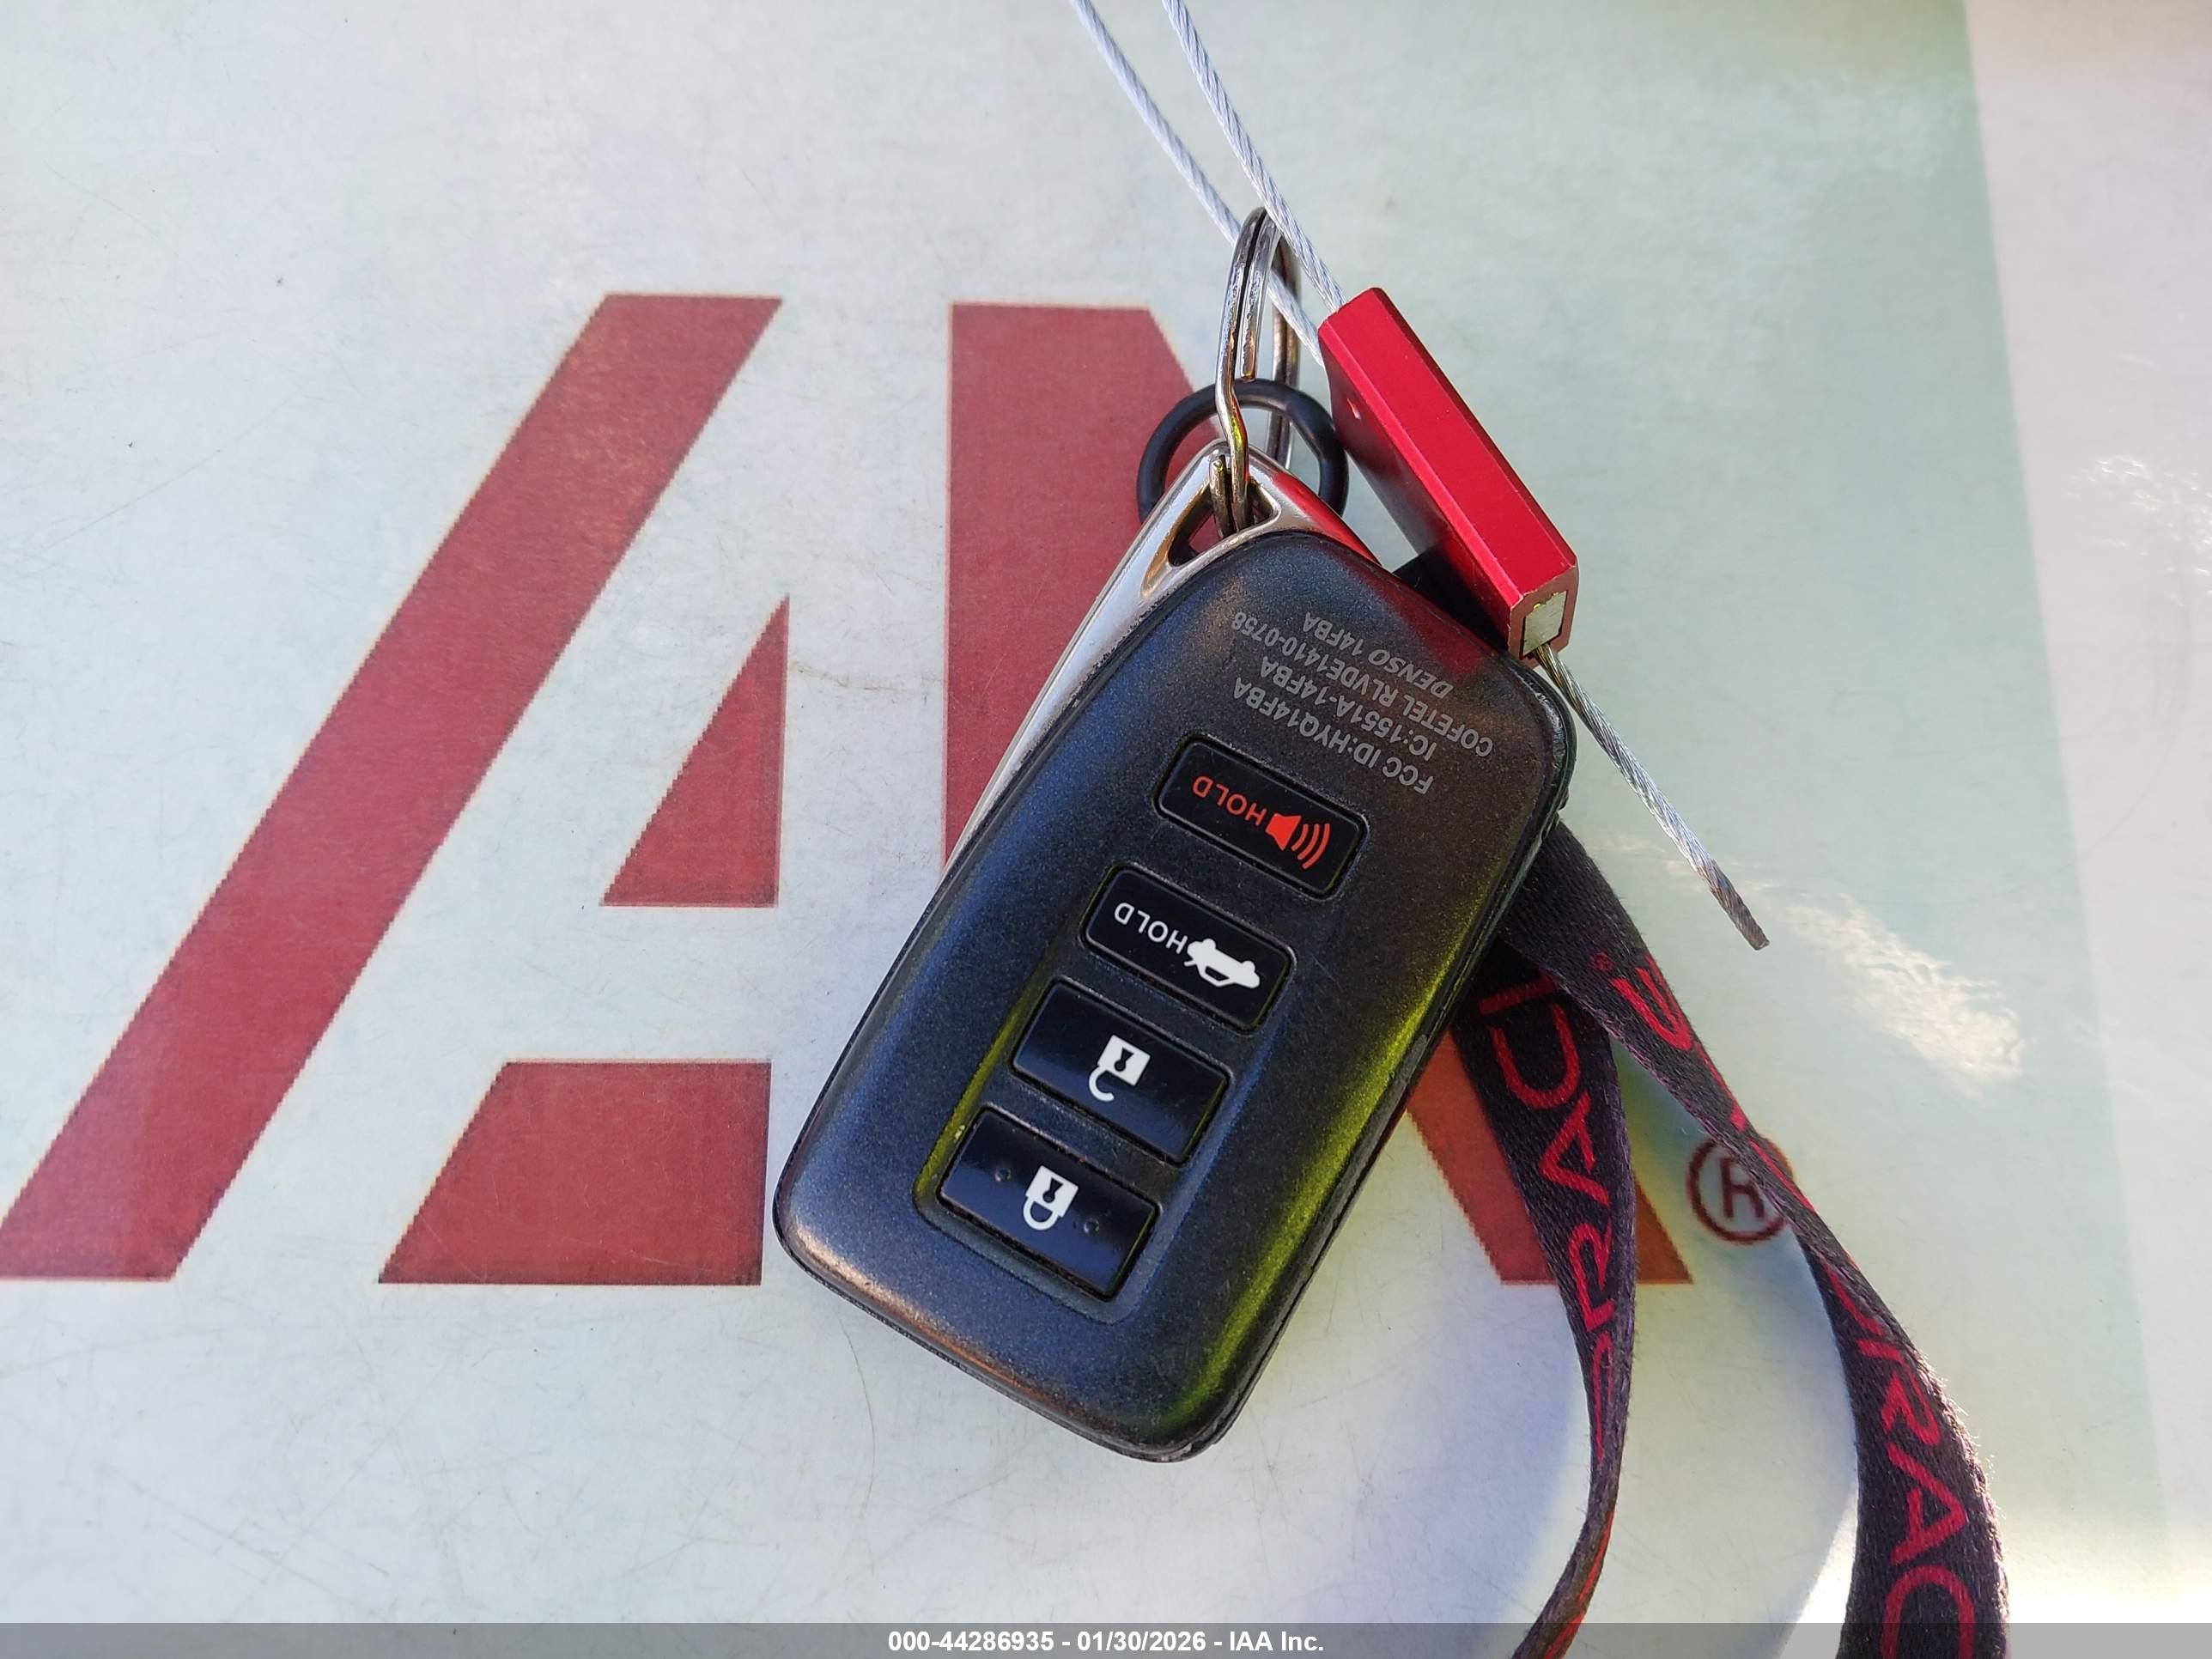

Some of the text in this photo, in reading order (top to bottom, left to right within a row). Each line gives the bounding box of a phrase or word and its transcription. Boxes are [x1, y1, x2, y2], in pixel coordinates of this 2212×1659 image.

[1231, 611, 1493, 757] COFETEL RLVDE1410-0758
[1303, 612, 1454, 699] DENSO 14FBA
[1233, 677, 1433, 794] FCC ID:HYQ14FBA
[1260, 655, 1437, 762] IC:1551A-14FBA
[1192, 775, 1267, 825] HOLD
[1114, 902, 1188, 954] HOLD
